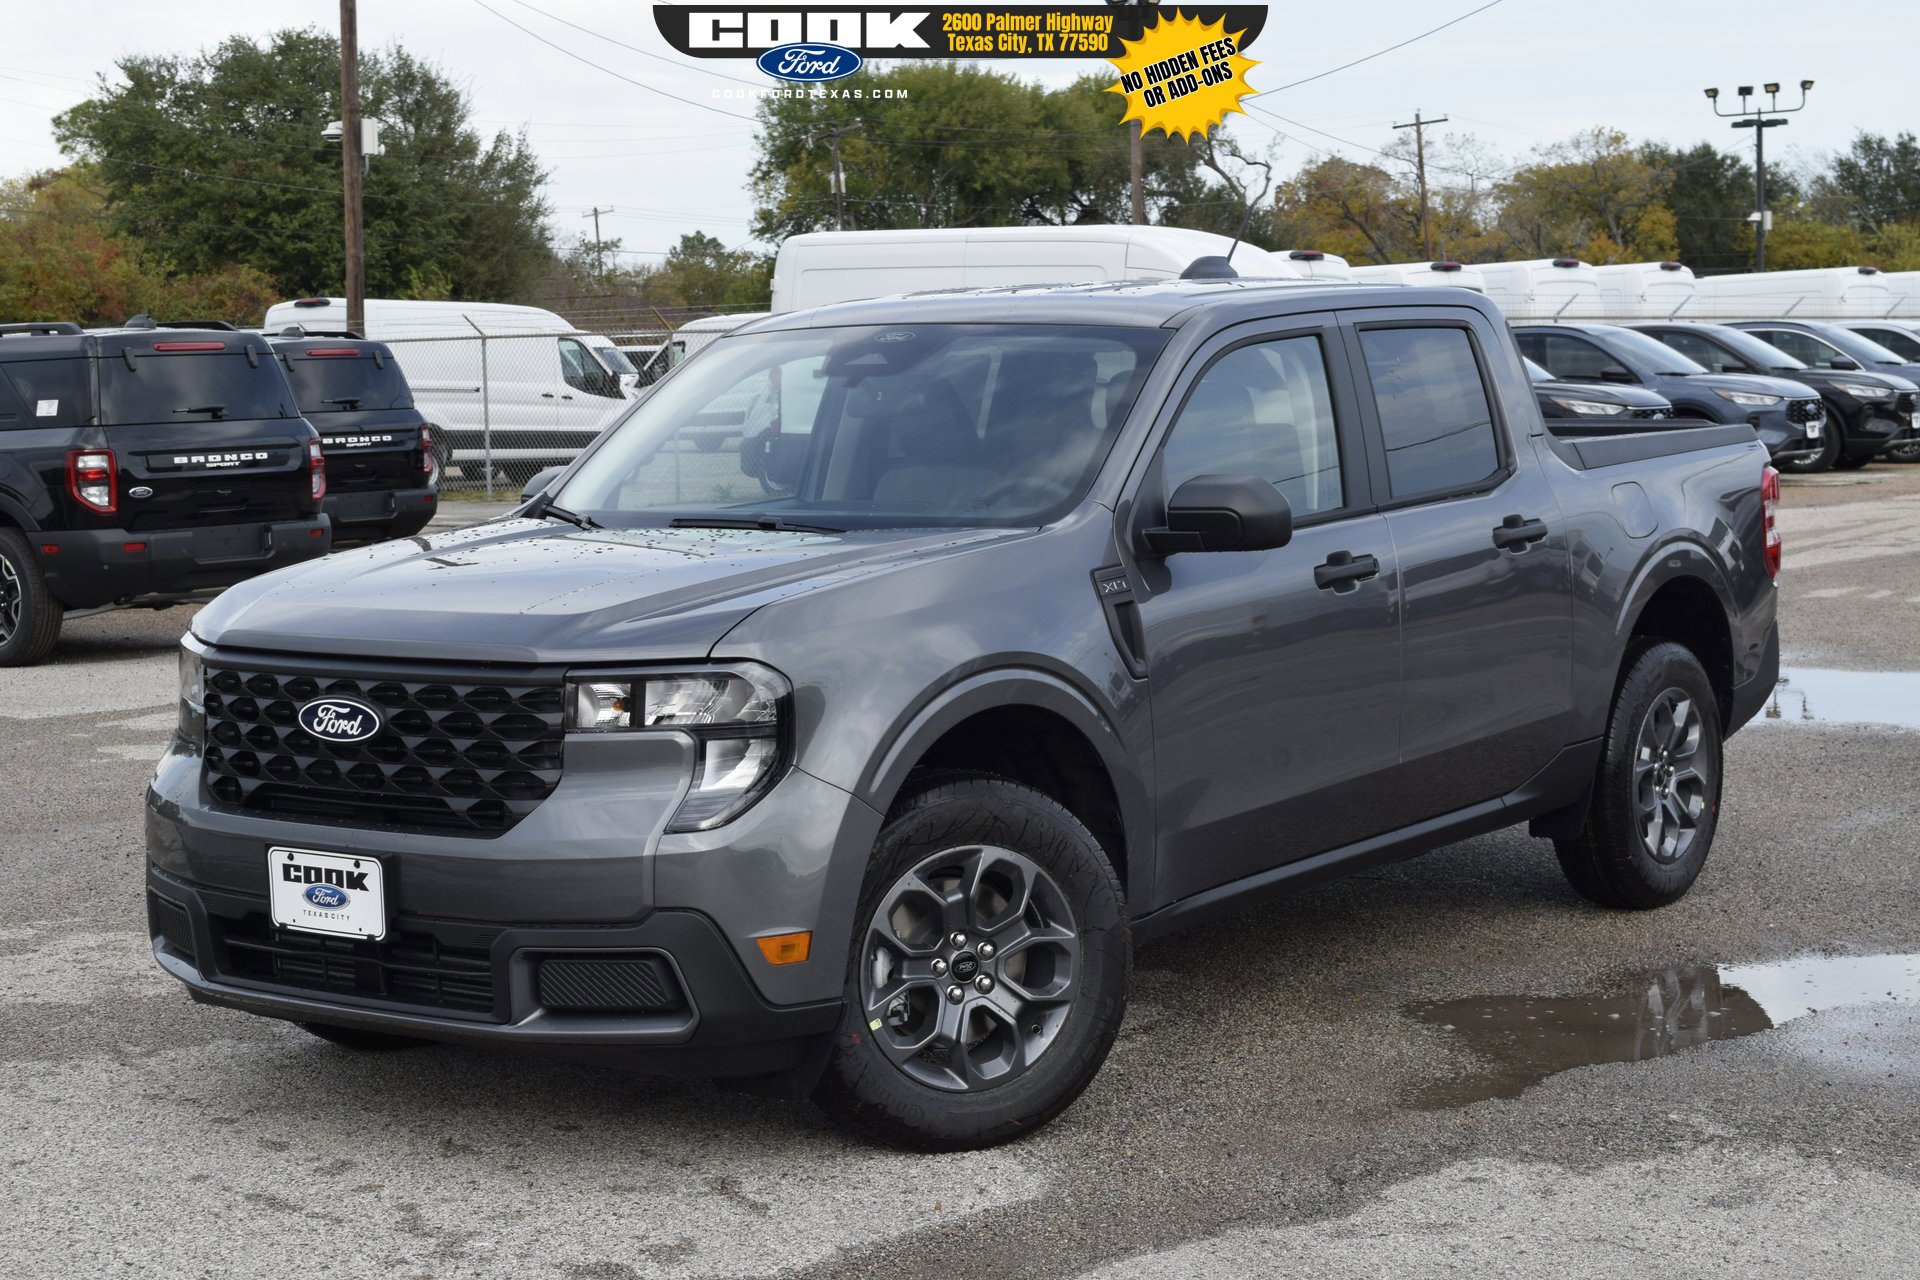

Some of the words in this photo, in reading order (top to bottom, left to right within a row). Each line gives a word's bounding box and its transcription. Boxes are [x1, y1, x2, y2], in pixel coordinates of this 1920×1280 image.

[322, 435, 392, 444] BRONCO
[174, 452, 268, 464] BRONCO
[313, 704, 363, 736] Ford
[282, 863, 370, 892] COOK
[312, 887, 339, 905] Ford
